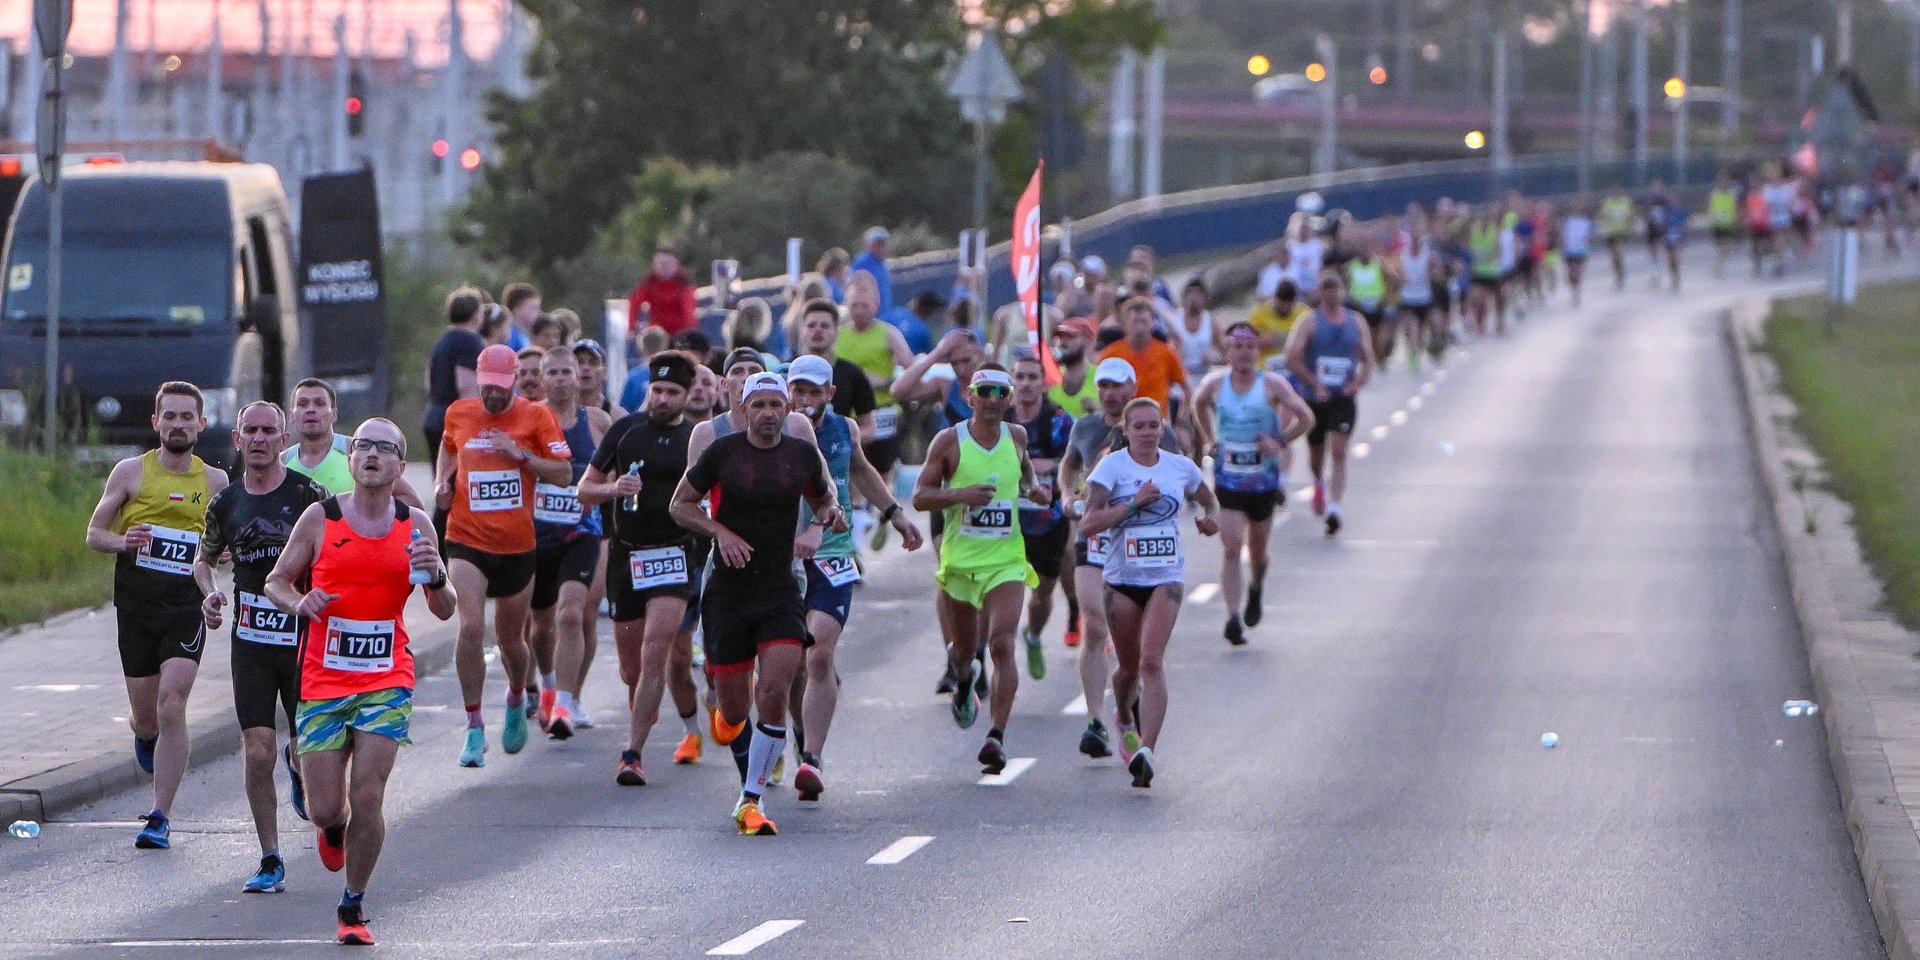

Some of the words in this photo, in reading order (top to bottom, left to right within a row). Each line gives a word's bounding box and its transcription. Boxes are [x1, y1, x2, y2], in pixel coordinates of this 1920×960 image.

[480, 481, 520, 498] 3620
[980, 511, 1006, 525] 419
[161, 541, 188, 560] 712
[1138, 539, 1175, 555] 3359
[643, 558, 684, 577] 3958
[255, 611, 289, 630] 647
[347, 636, 386, 655] 1710
